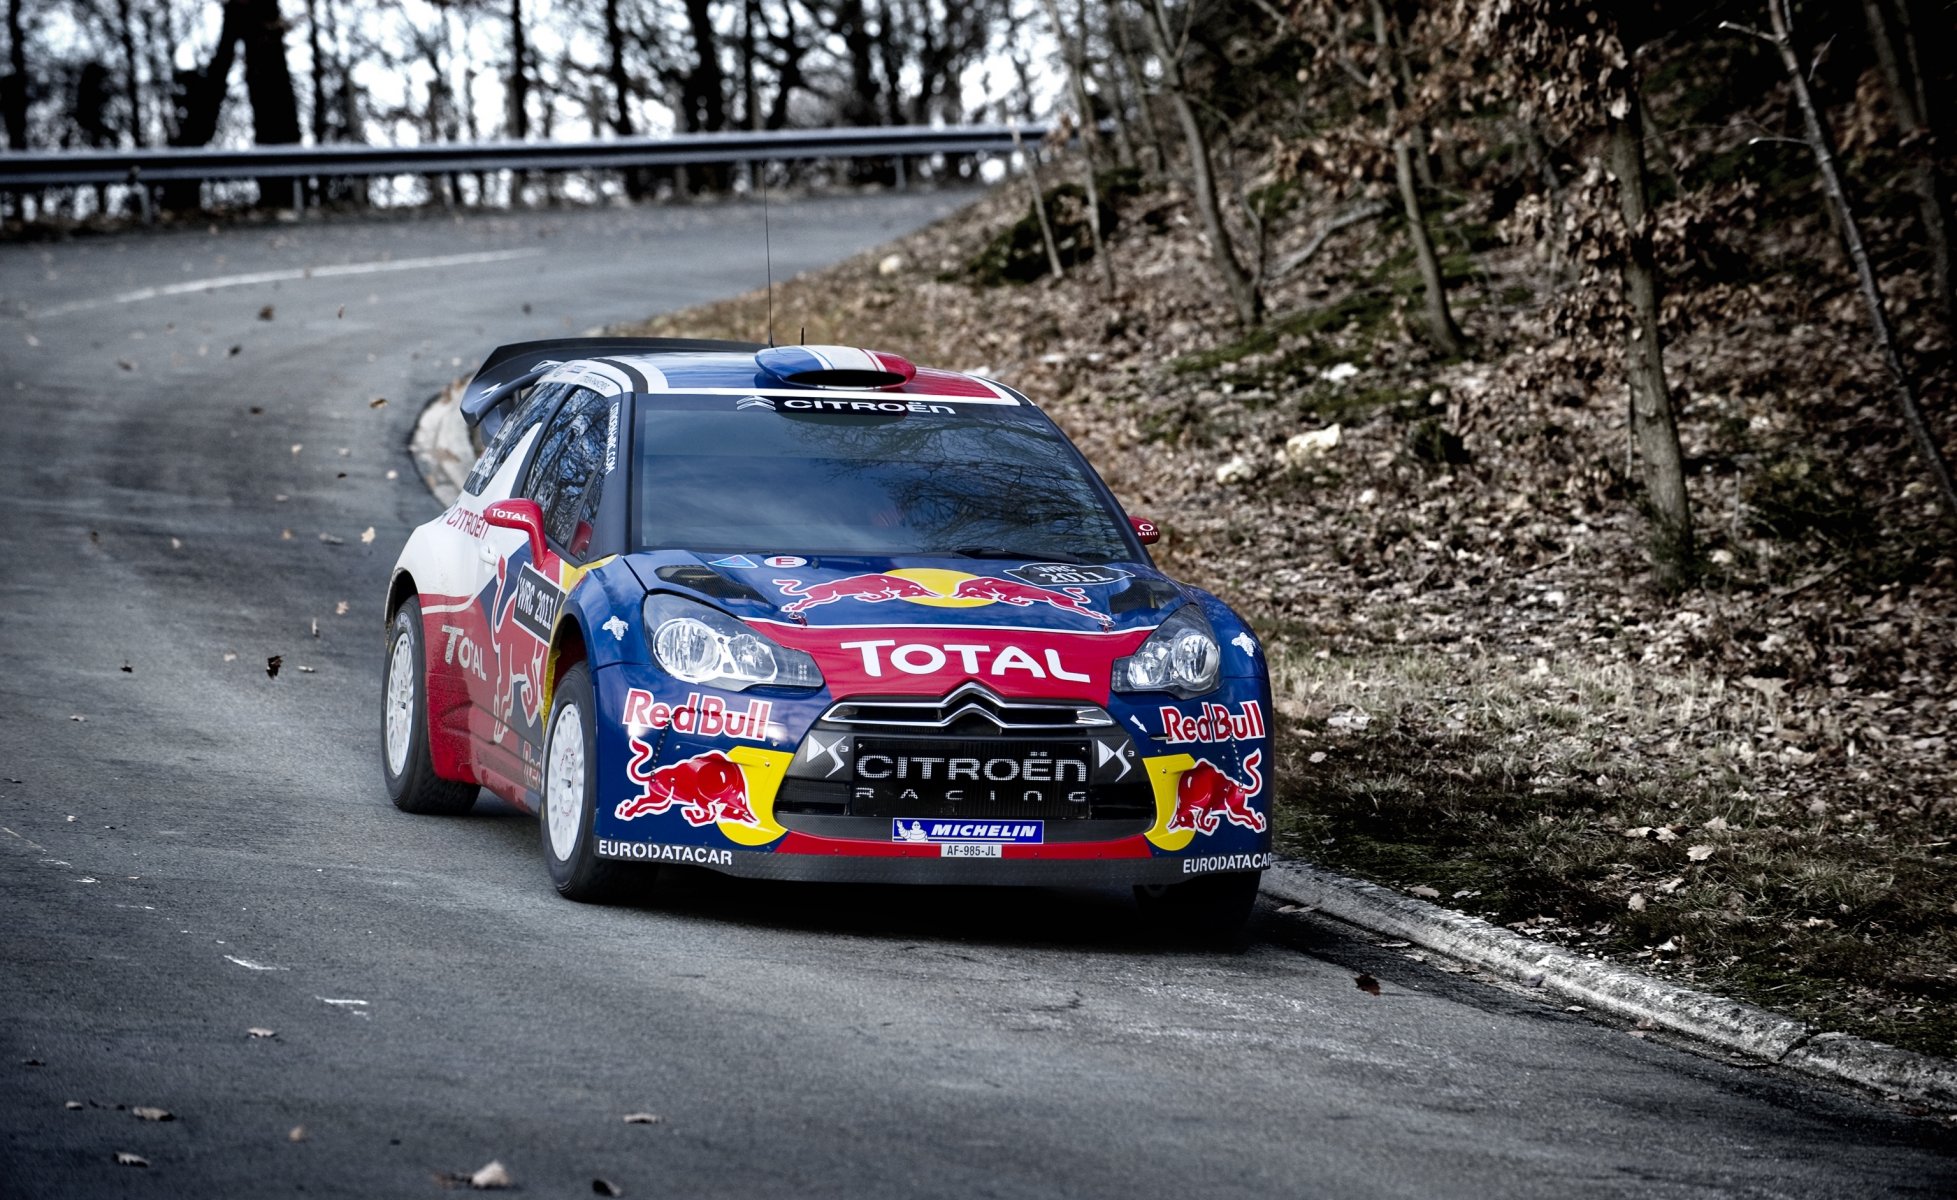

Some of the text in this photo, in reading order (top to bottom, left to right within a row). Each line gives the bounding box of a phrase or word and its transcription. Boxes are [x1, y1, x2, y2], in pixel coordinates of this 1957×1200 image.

[492, 508, 530, 522] TOTAL
[776, 557, 796, 566] E
[1039, 571, 1114, 583] 2011
[517, 576, 555, 631] WRC 2011
[441, 624, 487, 682] TOTAL
[840, 639, 1092, 683] TOTAL
[931, 823, 1038, 837] MICHELIN
[599, 839, 733, 866] EURODATACAR
[946, 845, 997, 857] AF-985-JL
